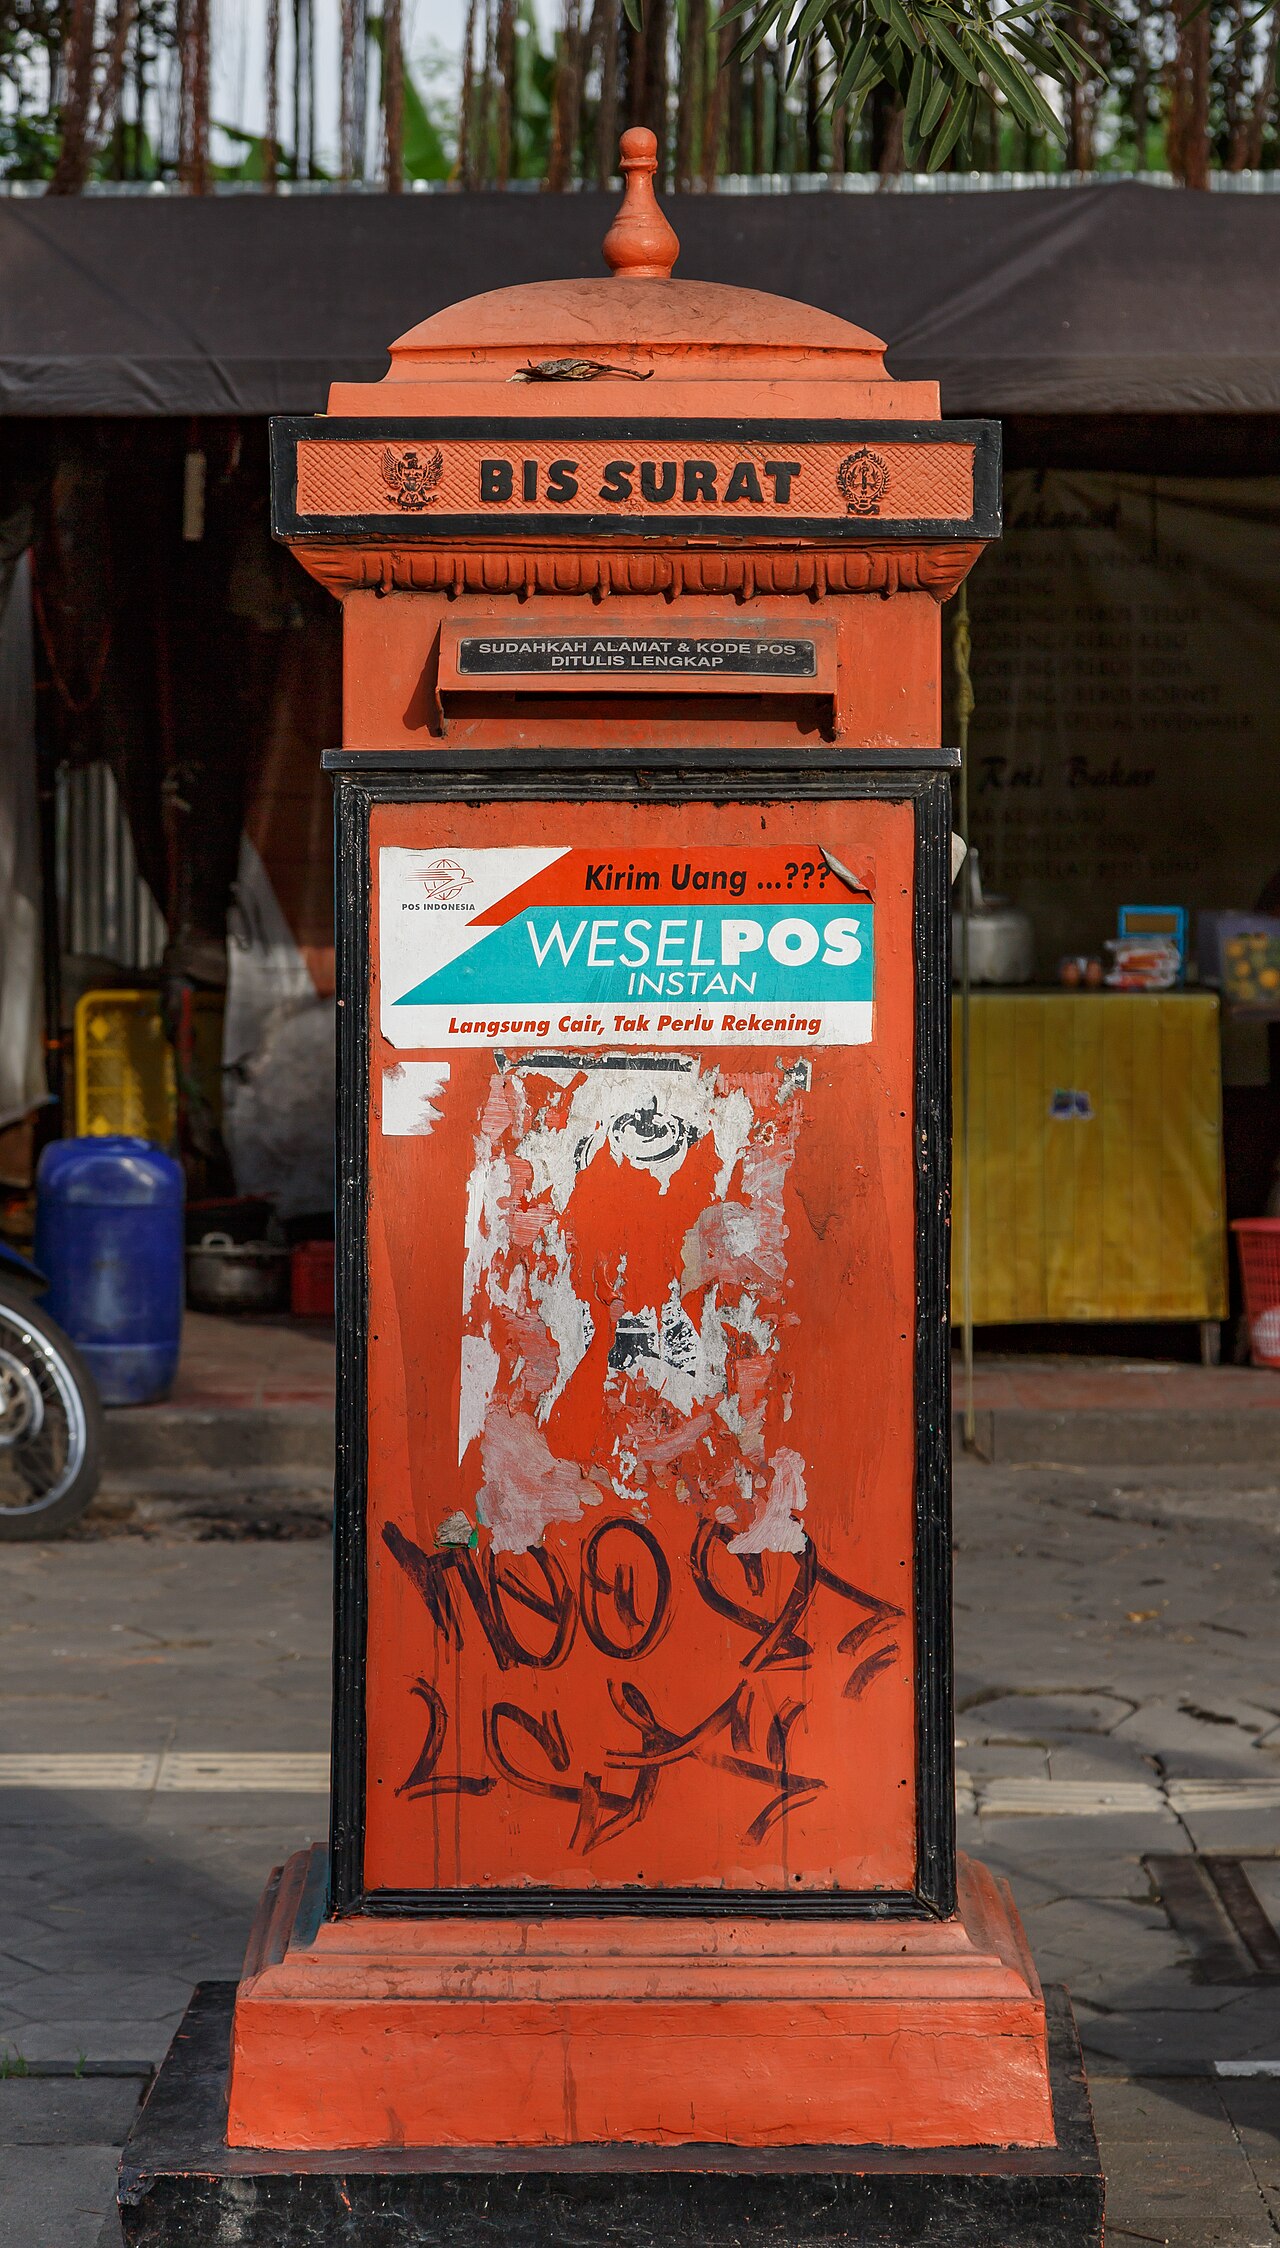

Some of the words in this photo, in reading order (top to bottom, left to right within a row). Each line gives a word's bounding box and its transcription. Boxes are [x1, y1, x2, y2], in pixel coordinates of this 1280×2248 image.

[479, 459, 581, 504] BIS
[598, 460, 802, 505] SURAT
[478, 641, 587, 655] SUDAHKAH
[592, 641, 672, 655] ALAMAT
[677, 642, 690, 654] &
[696, 642, 751, 656] KODE
[756, 643, 797, 656] POS
[550, 655, 625, 668] DITULIS
[630, 655, 725, 668] LENGKAP
[584, 863, 660, 891] Kirim
[671, 863, 748, 897] Uang
[402, 903, 420, 911] POS
[423, 903, 476, 911] INDONESIA
[627, 971, 757, 996] INSTAN
[448, 1016, 551, 1037] Langsung
[558, 1014, 605, 1036] Cair,
[614, 1015, 650, 1033] Tak
[657, 1013, 714, 1033] Perlu
[721, 1012, 822, 1036] Rekening
